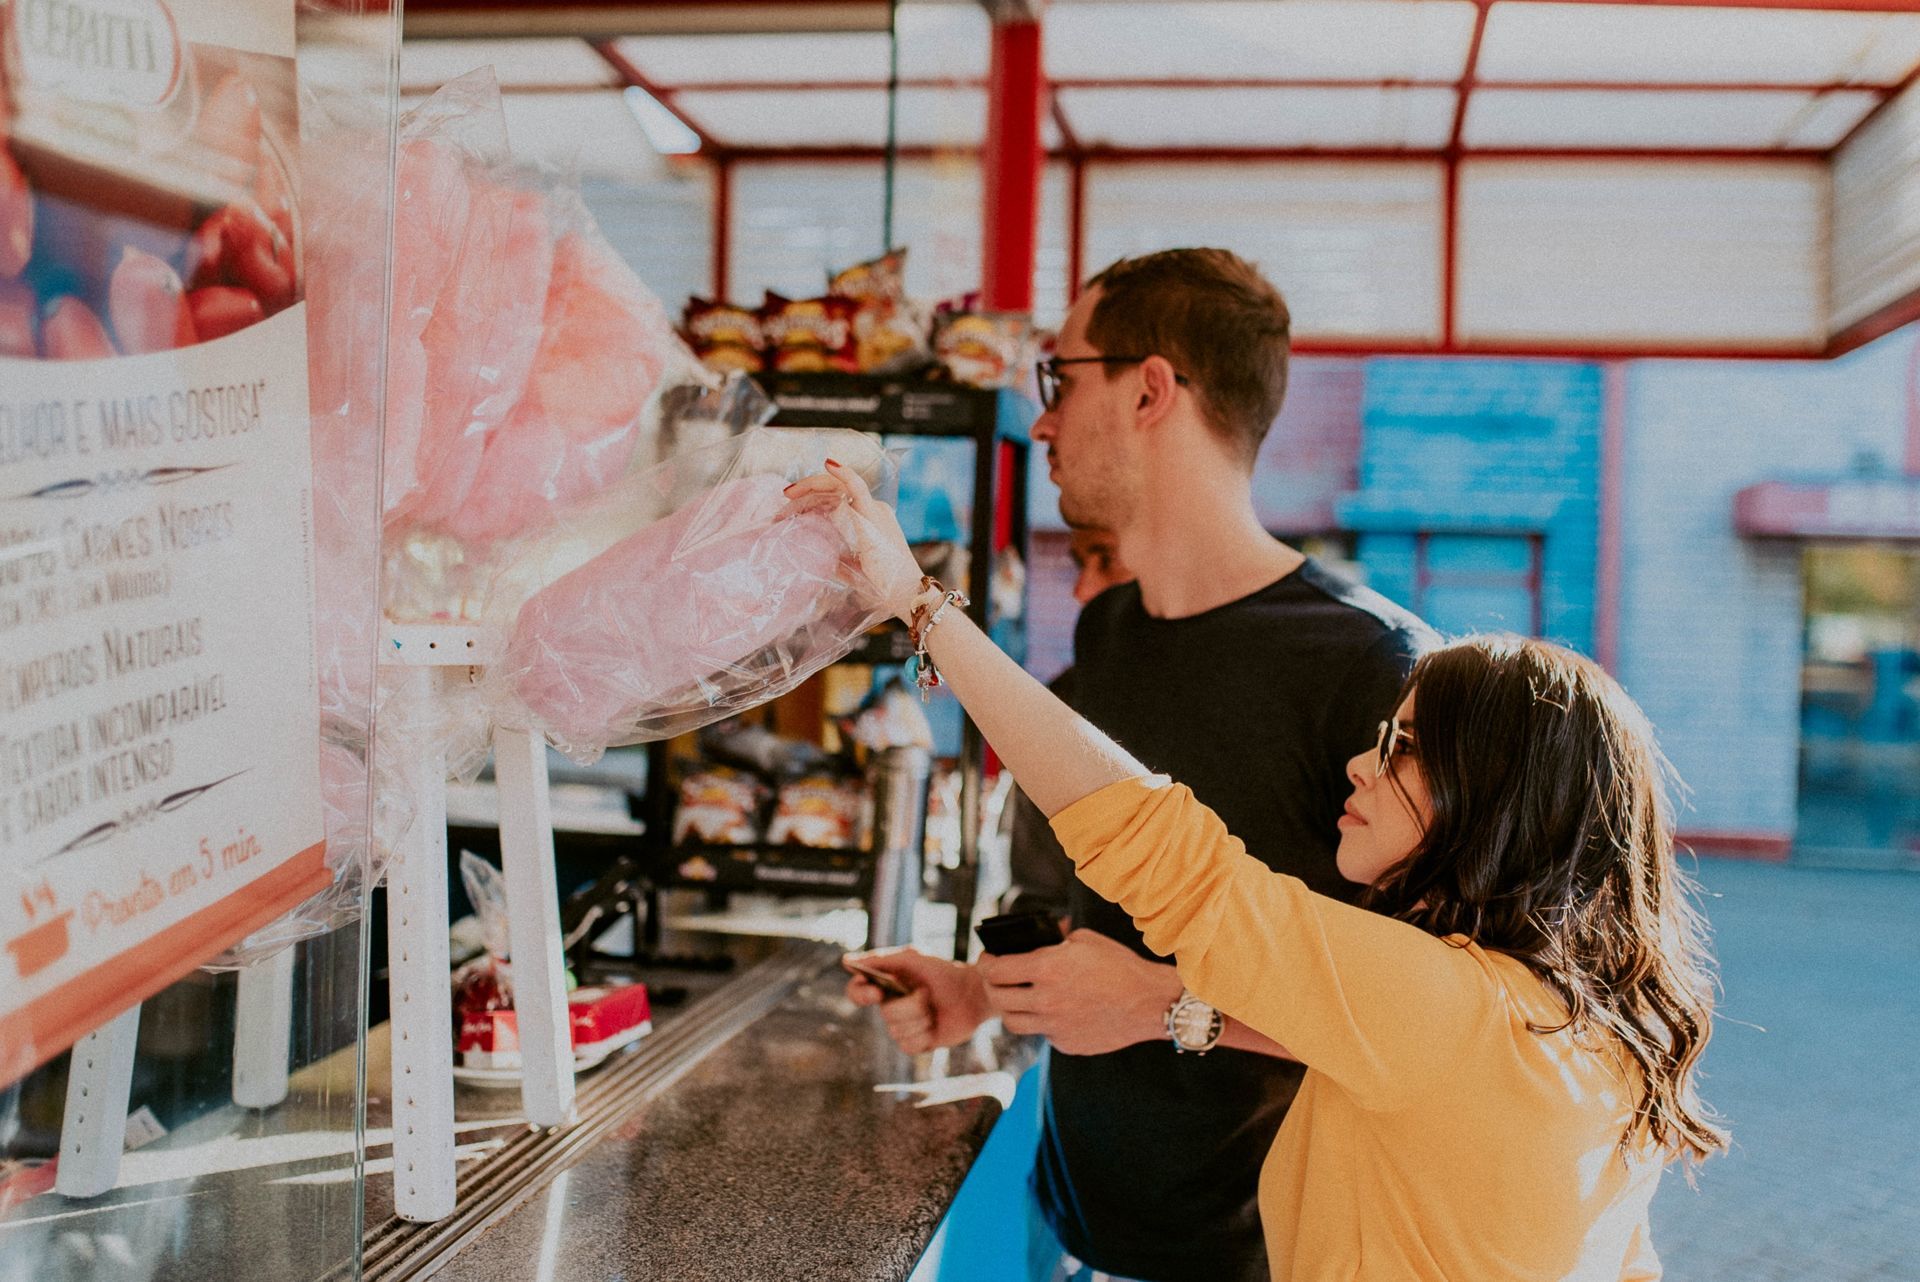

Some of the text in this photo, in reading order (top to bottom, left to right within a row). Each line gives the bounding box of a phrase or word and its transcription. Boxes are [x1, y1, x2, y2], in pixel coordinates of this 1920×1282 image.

[99, 394, 164, 451] MAIS
[102, 617, 204, 680] NATURAIS
[89, 738, 175, 801] INTENSO
[198, 836, 216, 881] 5
